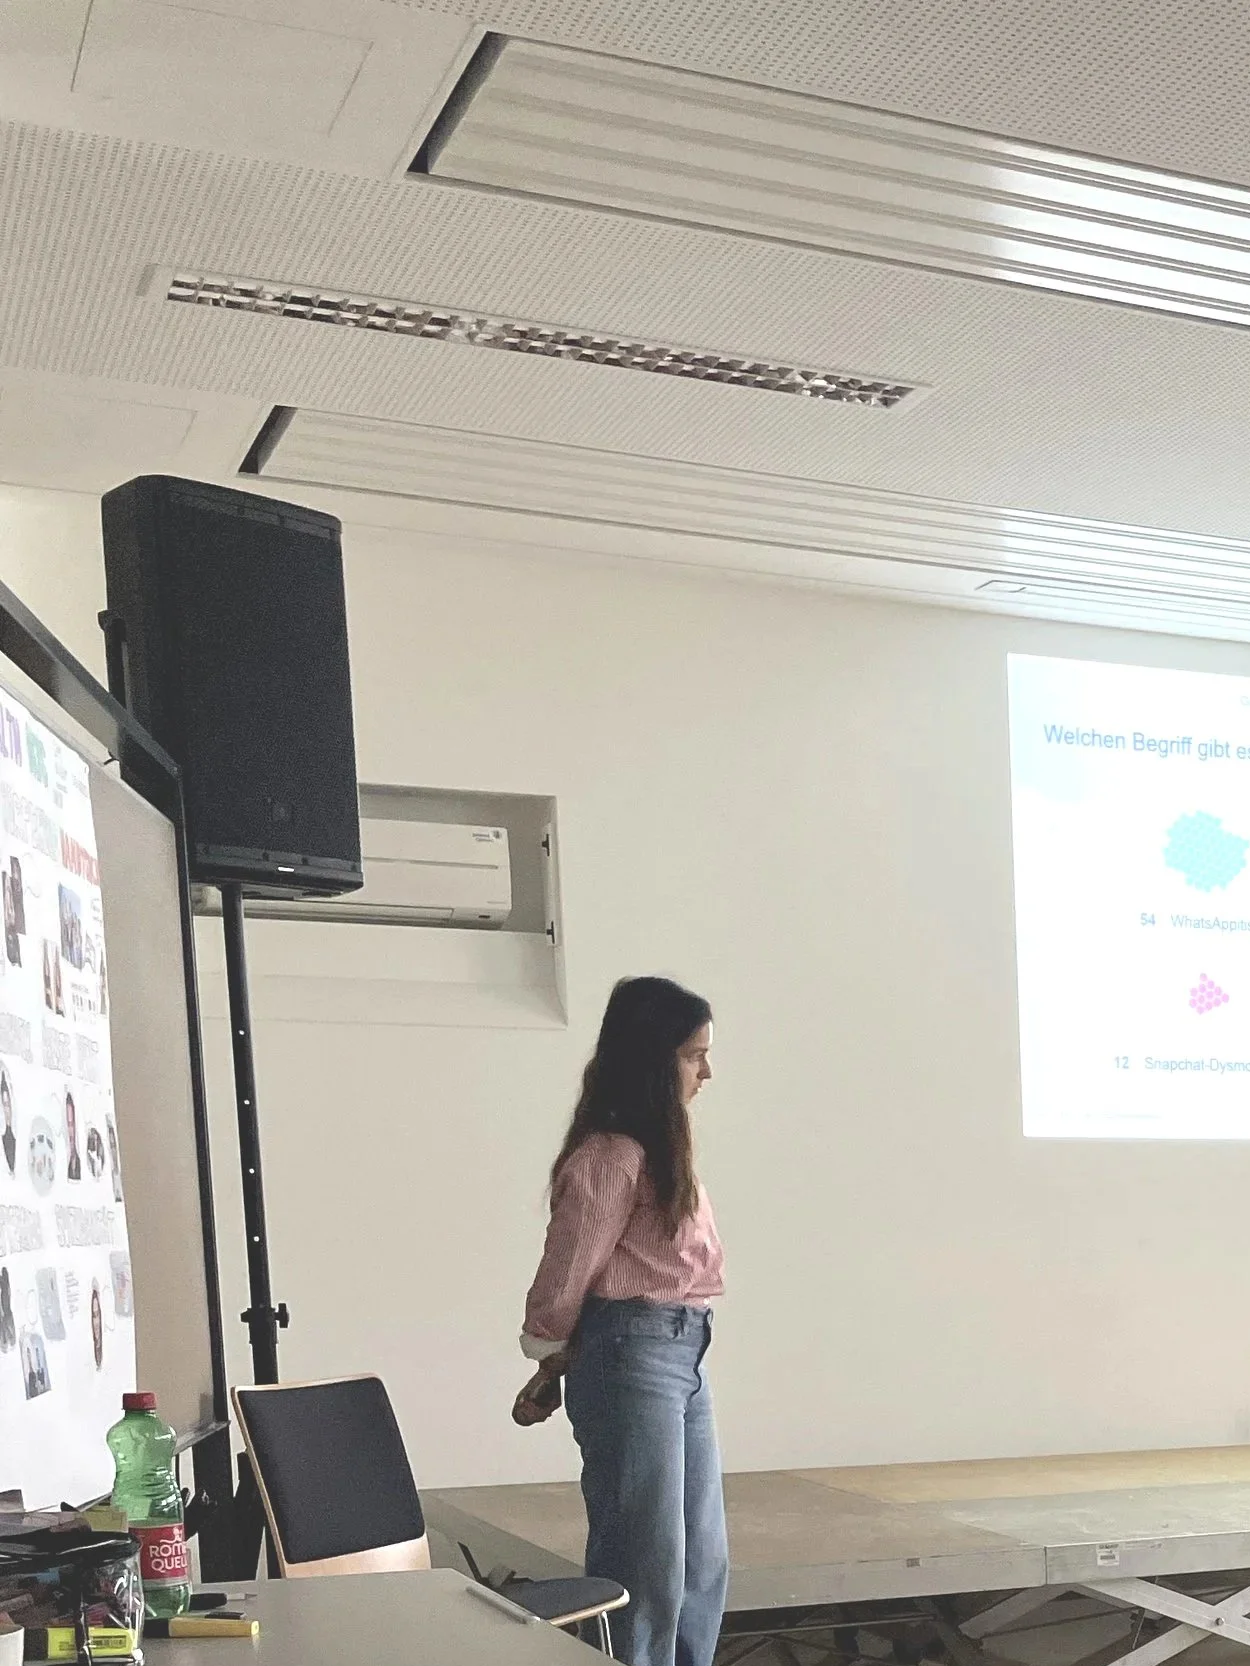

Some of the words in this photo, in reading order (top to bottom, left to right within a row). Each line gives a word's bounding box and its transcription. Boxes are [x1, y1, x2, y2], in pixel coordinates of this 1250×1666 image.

[1043, 723, 1126, 752] Welchen
[1133, 730, 1192, 761] Begriff
[1197, 737, 1230, 763] gibt
[1140, 913, 1156, 927] 54
[1113, 1056, 1130, 1070] 12
